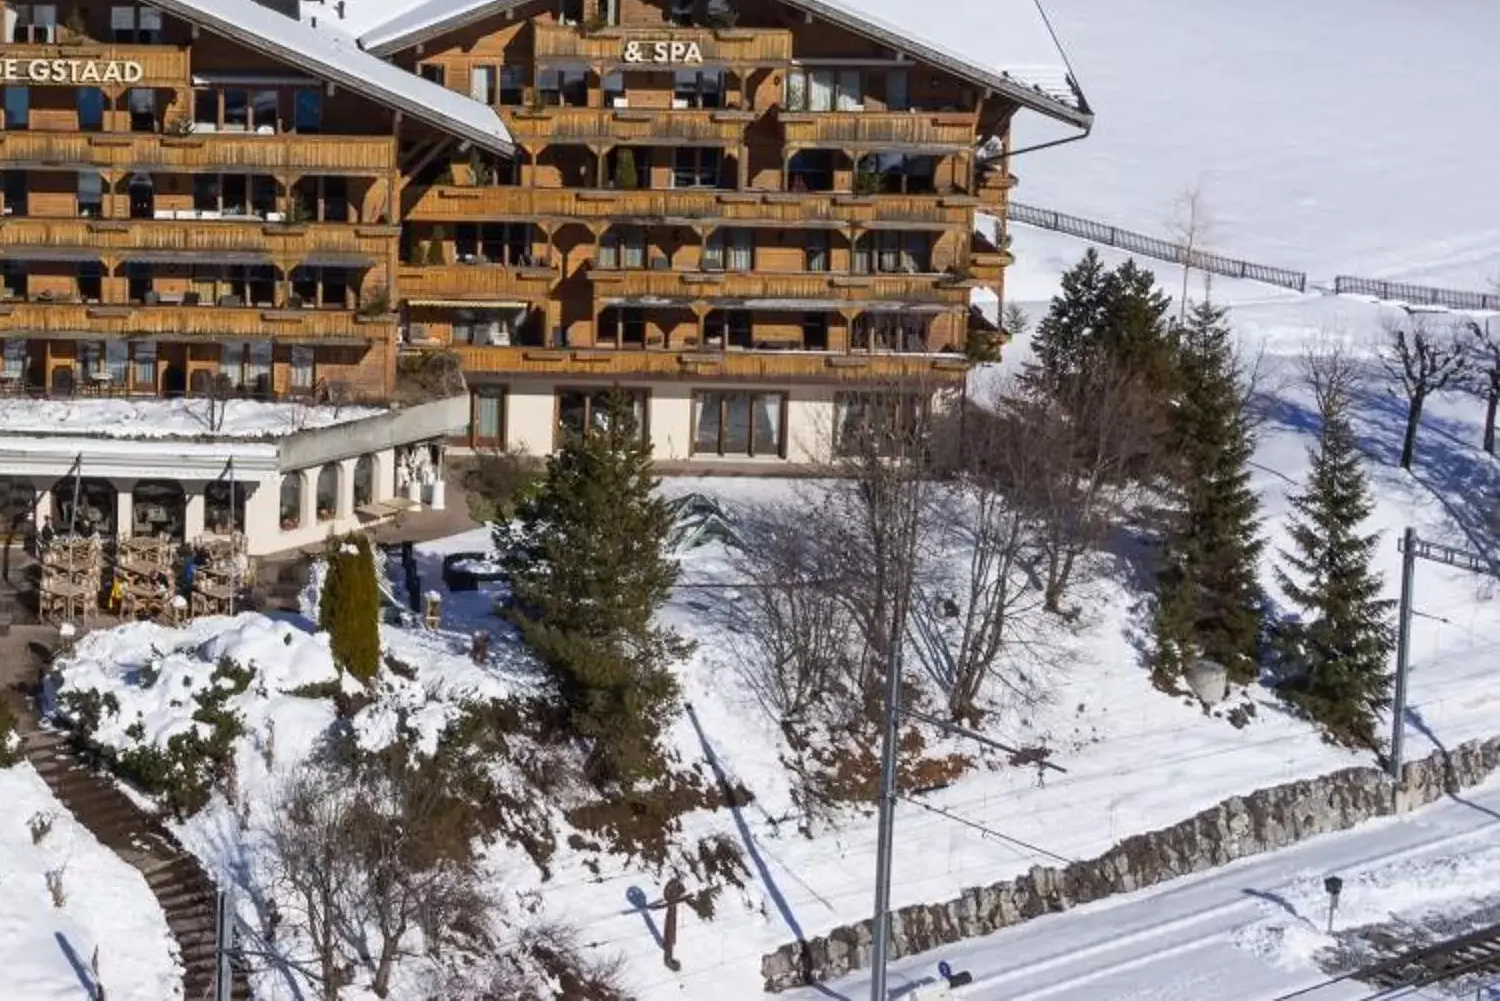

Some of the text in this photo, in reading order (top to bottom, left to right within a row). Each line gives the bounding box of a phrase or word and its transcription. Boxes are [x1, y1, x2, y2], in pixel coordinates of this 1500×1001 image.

[624, 40, 703, 63] & SPA
[28, 58, 144, 83] GSTAAD
